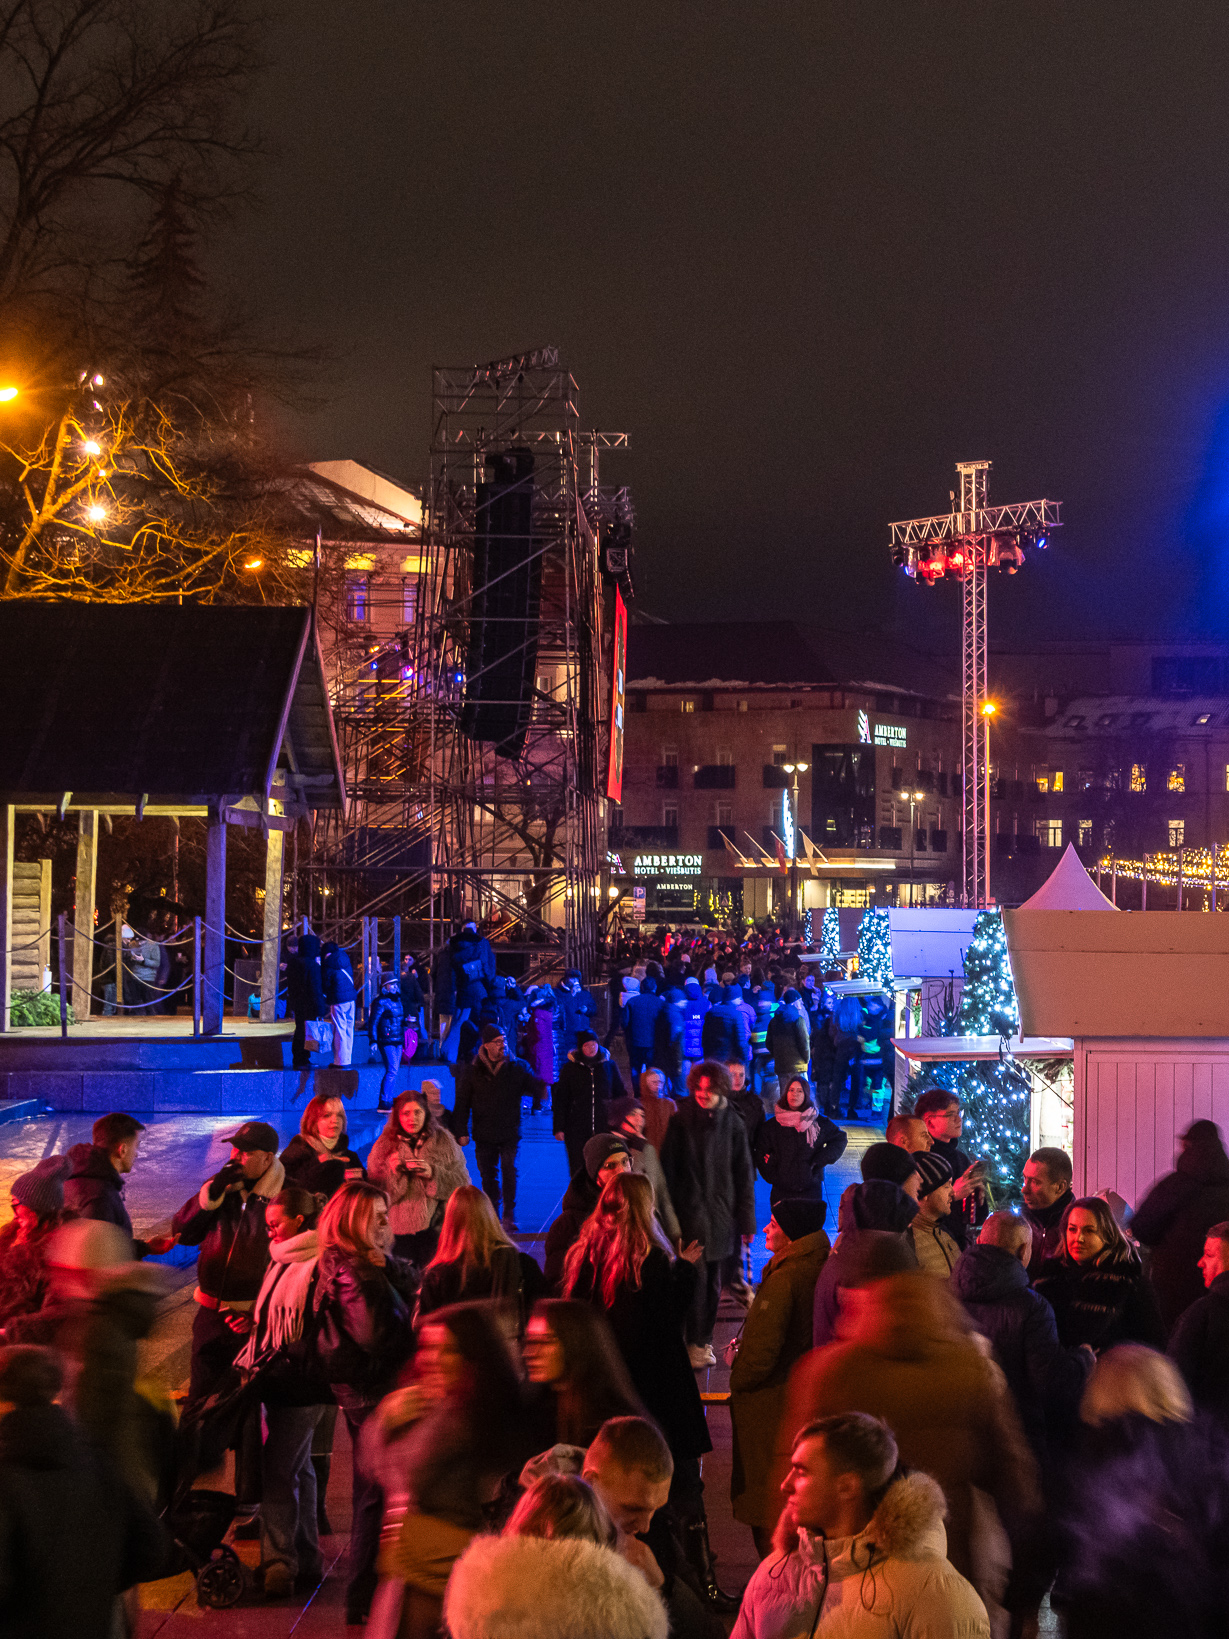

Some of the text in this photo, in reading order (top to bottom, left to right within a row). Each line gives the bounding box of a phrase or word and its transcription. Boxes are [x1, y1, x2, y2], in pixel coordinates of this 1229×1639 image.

[874, 724, 907, 739] AMBERTON
[634, 855, 702, 866] AMBERTON
[665, 866, 702, 875] VIEŠBUTIS
[636, 888, 644, 898] P
